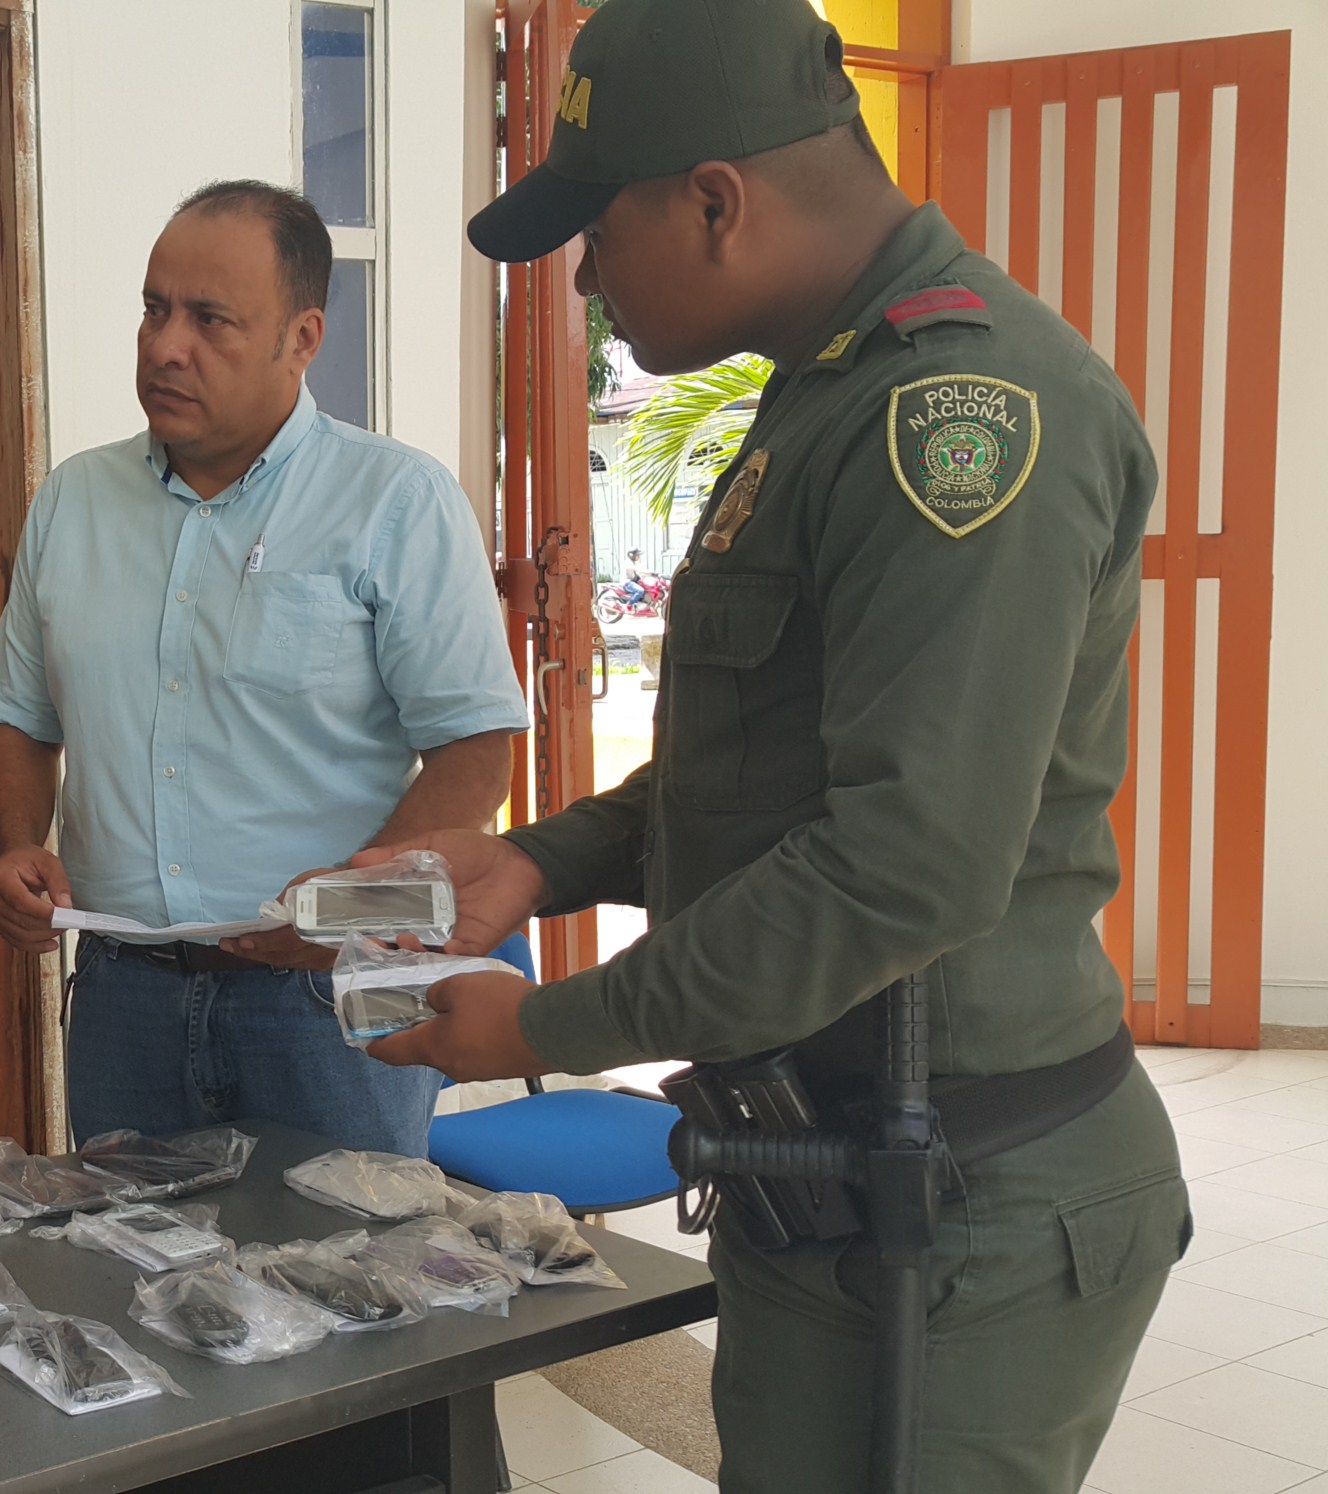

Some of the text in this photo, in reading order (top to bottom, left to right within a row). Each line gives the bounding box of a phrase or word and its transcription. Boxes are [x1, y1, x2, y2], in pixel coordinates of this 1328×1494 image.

[557, 64, 592, 130] IA
[924, 384, 1007, 410] POLICÍA
[908, 402, 1019, 432] NACIONAL
[926, 496, 995, 509] COLOMBIA
